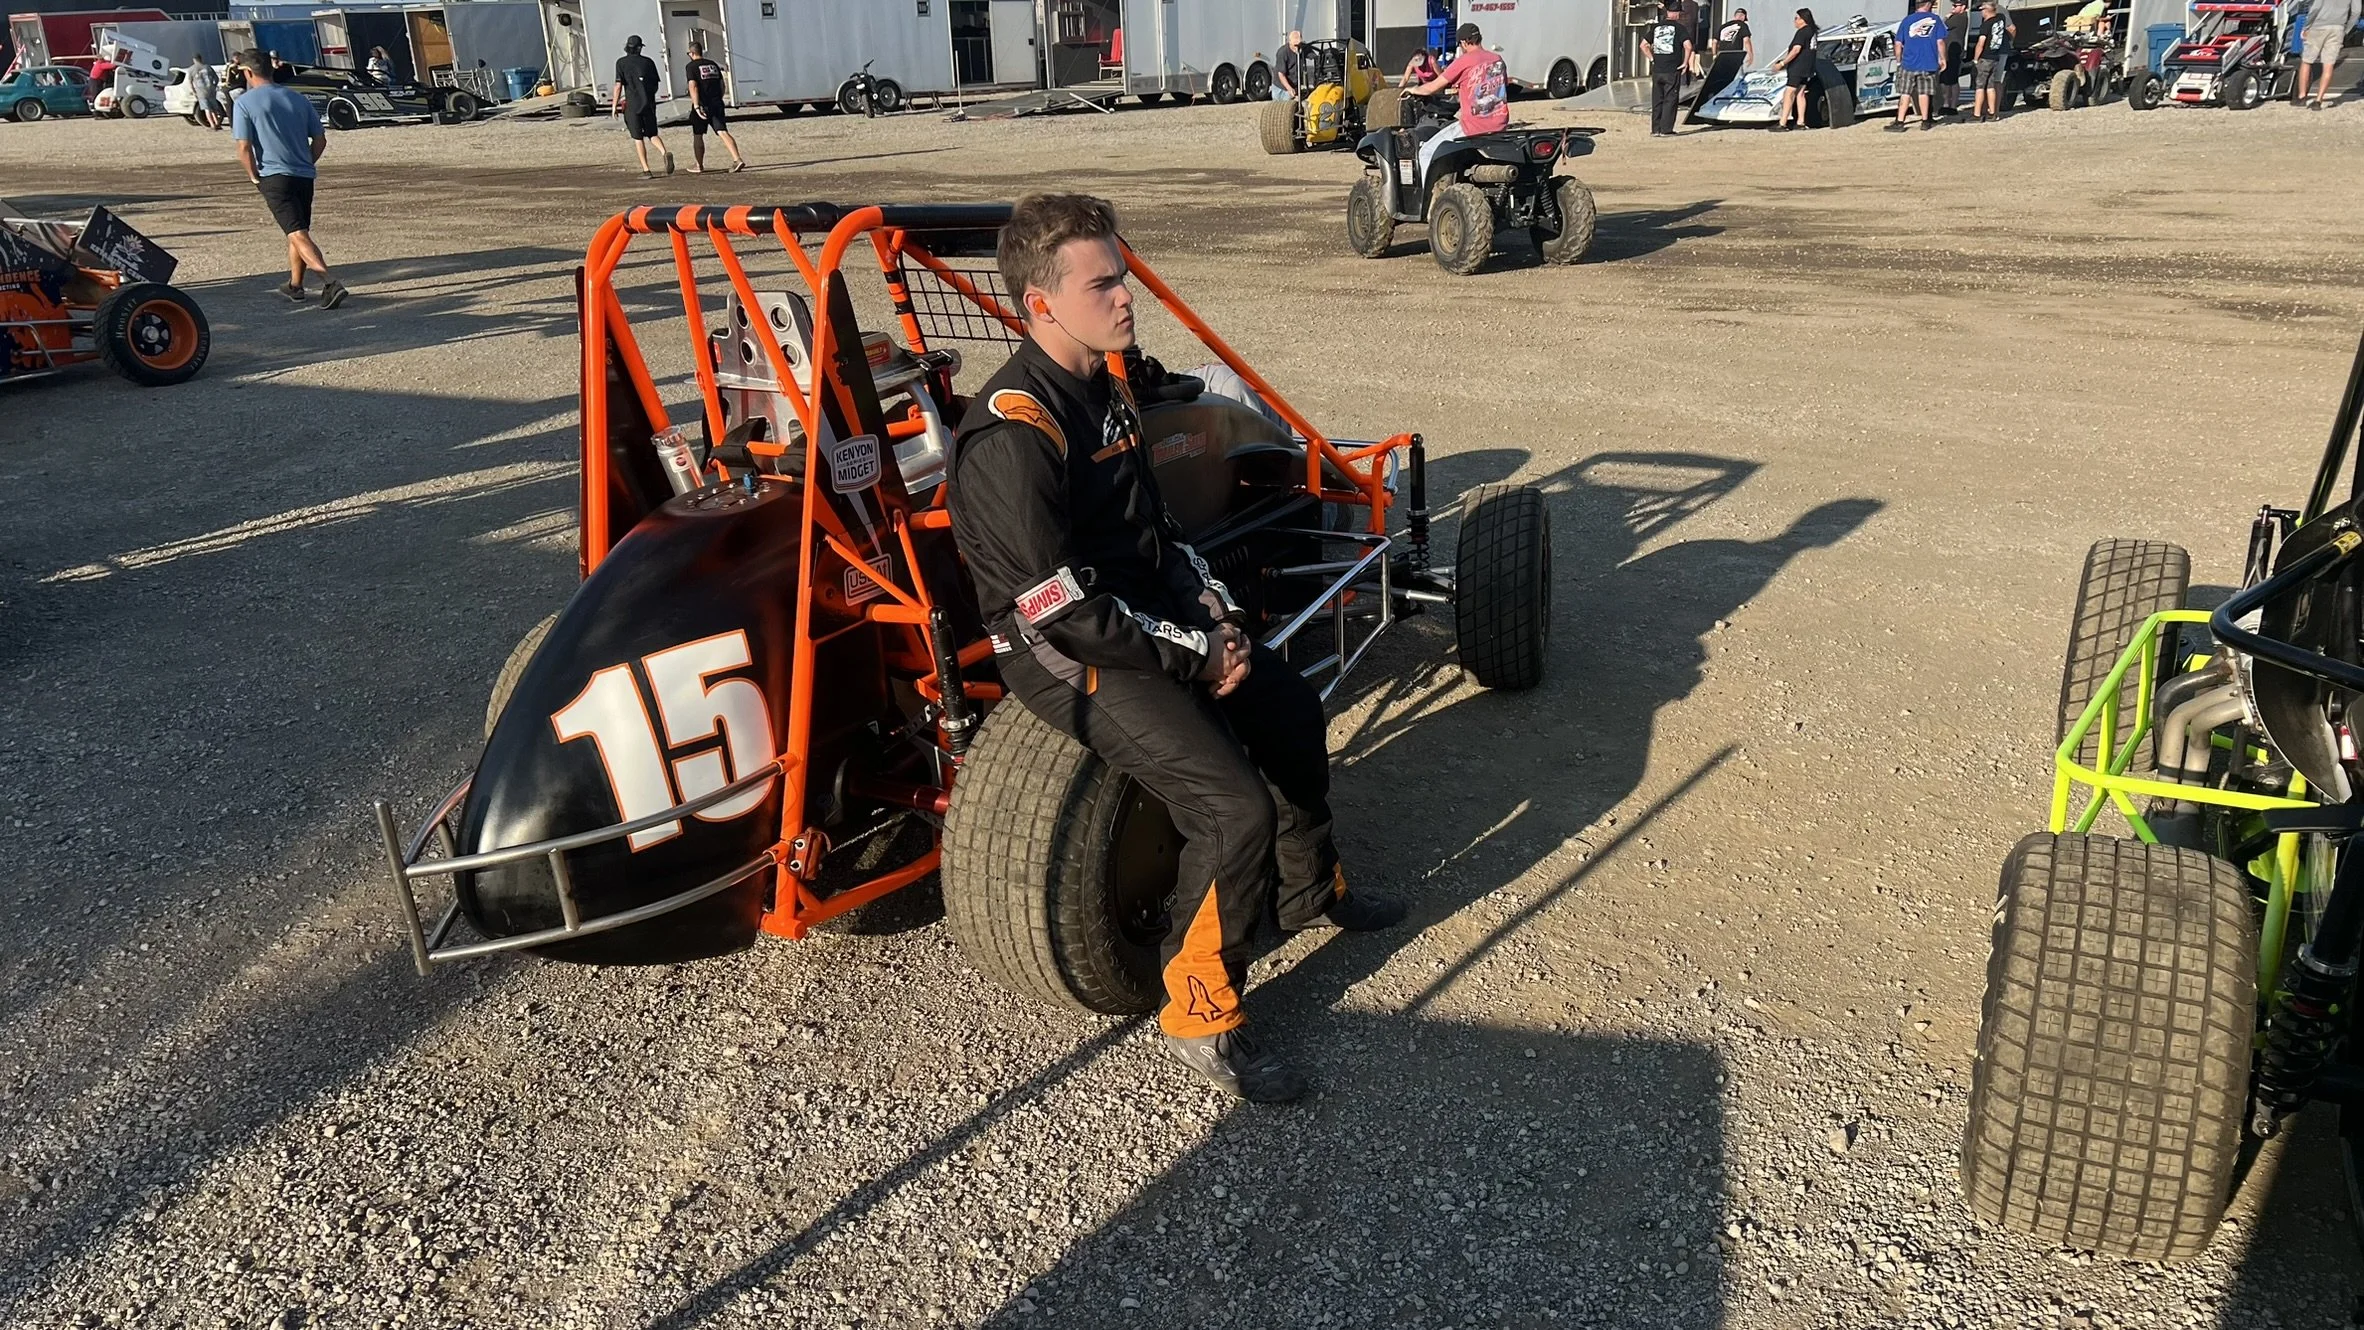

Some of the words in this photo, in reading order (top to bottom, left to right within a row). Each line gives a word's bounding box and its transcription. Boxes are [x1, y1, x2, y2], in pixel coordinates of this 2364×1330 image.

[353, 92, 394, 111] 96
[835, 442, 874, 464] KENYON
[837, 460, 875, 481] MIDGET
[551, 629, 776, 853] 15
